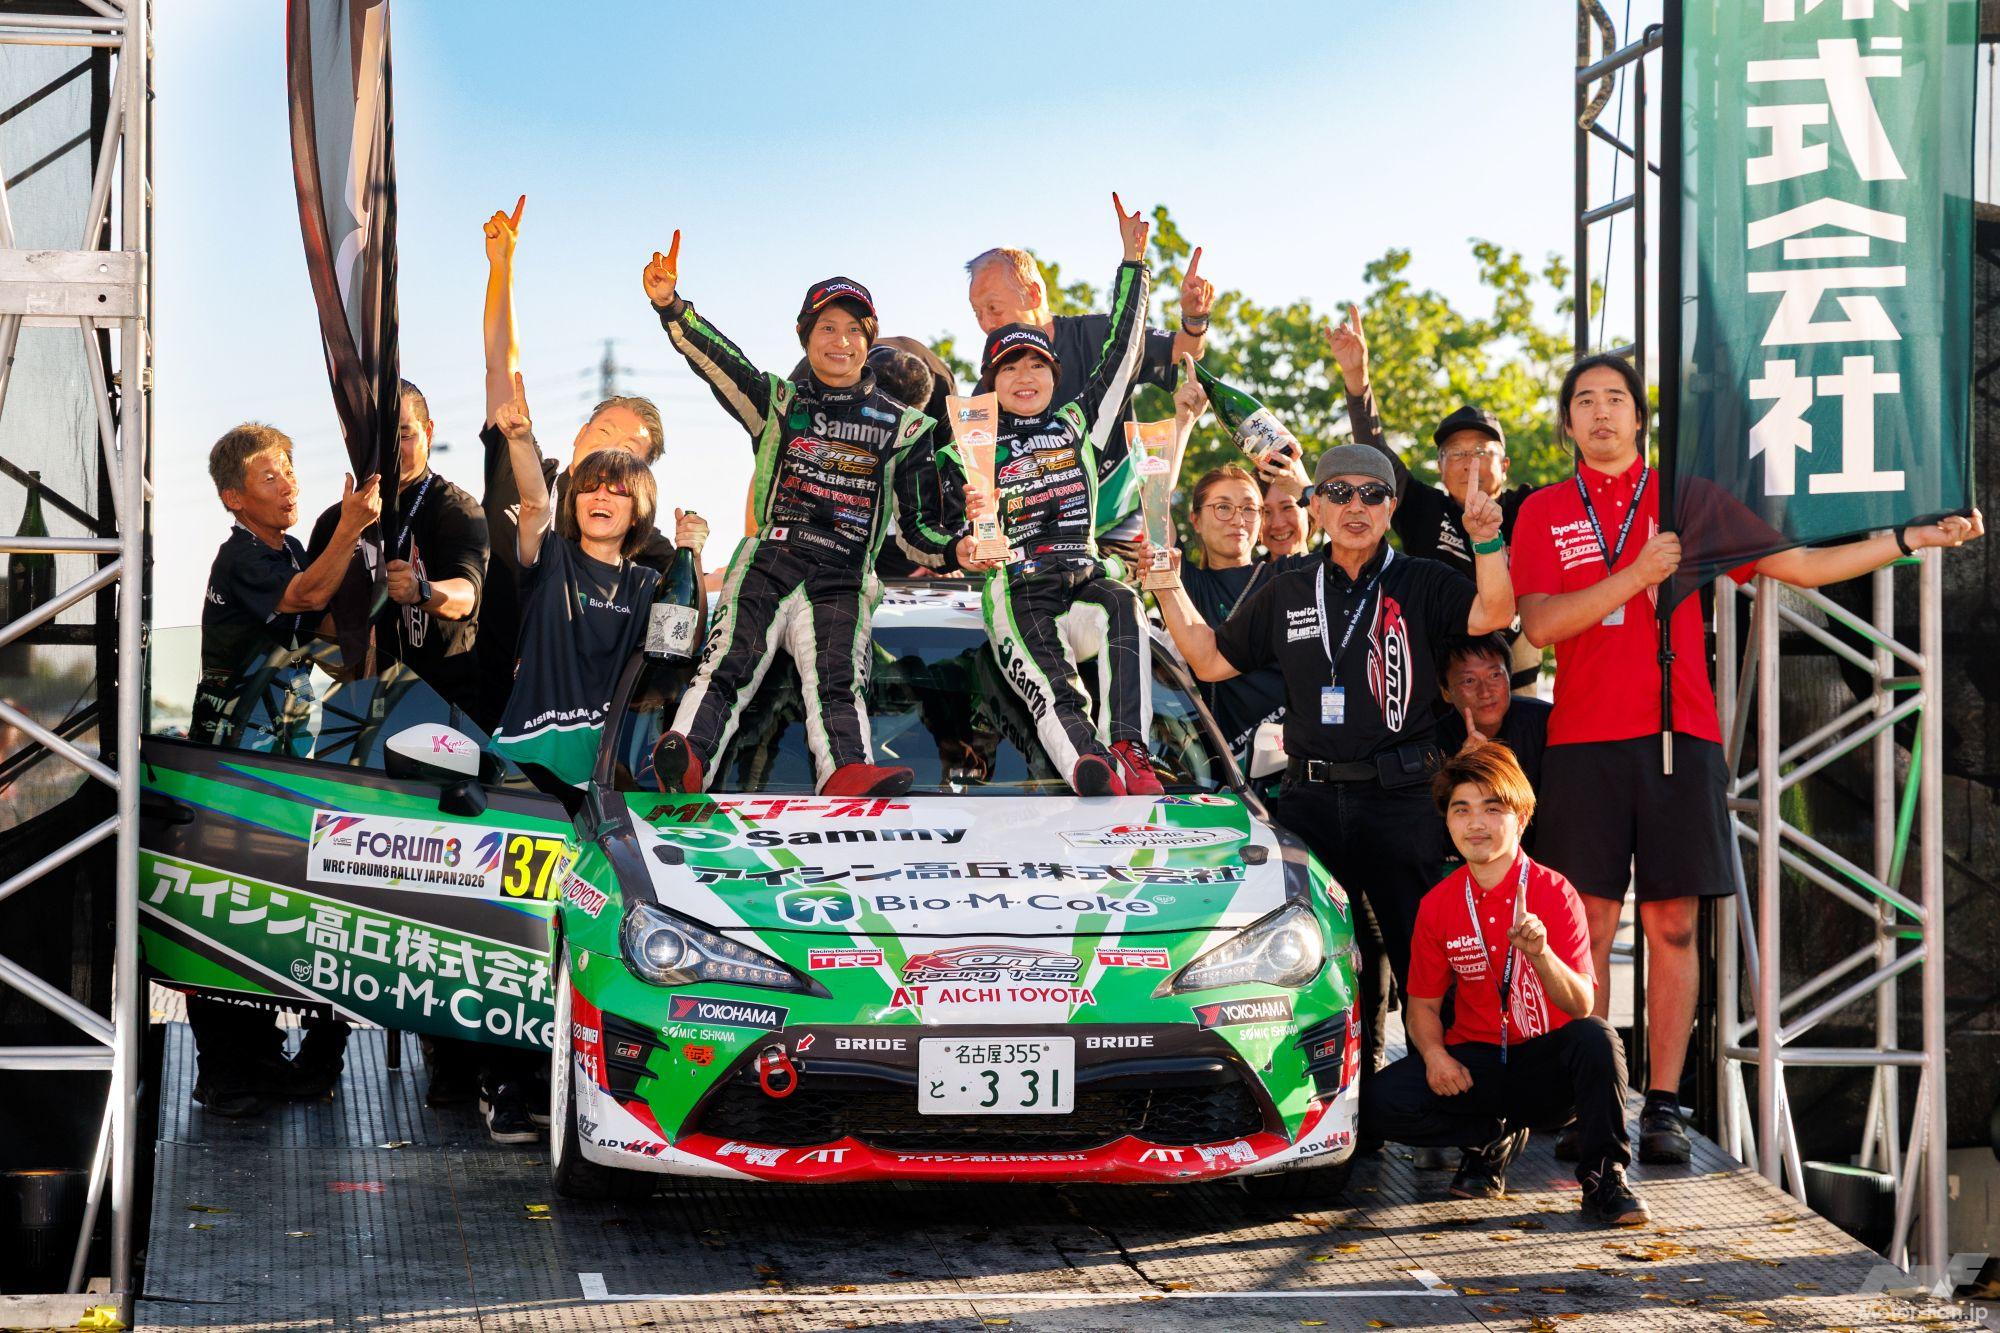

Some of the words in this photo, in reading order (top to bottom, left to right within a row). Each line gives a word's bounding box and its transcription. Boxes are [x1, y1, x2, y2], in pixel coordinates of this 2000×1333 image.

[1747, 0, 1909, 496] 式会社
[1001, 332, 1048, 349] YOKOHAMA
[813, 412, 892, 450] Sammy
[1011, 427, 1075, 458] Sammy
[831, 490, 871, 508] TOYOTA
[1007, 496, 1024, 514] AT
[1287, 608, 1306, 621] kyoei
[524, 710, 556, 729] AISIN
[746, 828, 967, 849] Sammy
[356, 830, 462, 868] FORUM8
[323, 858, 345, 874] WRC
[347, 861, 389, 878] FORUM8
[390, 866, 423, 882] RALLY
[424, 869, 457, 886] JAPAN
[458, 872, 485, 888] 2026
[504, 836, 564, 898] 37
[691, 861, 1246, 887] アイシン高丘株式会社
[569, 879, 607, 916] TOYOTA
[812, 954, 882, 967] TRD
[1101, 954, 1168, 968] TRD
[905, 970, 999, 983] Racing
[1011, 970, 1080, 983] Team
[890, 986, 929, 1008] AT
[938, 988, 1001, 1003] AICHI
[1006, 988, 1097, 1005] TOYOTA
[698, 1003, 776, 1025] YOKOHAMA
[1222, 1002, 1287, 1021] YOKOHAMA
[662, 1024, 697, 1039] SOMIC
[836, 1039, 906, 1051] BRIDE
[1086, 1035, 1154, 1048] BRIDE
[1315, 1044, 1335, 1057] GR
[617, 1047, 639, 1057] GR
[598, 1139, 658, 1156] ADVAN
[1300, 1134, 1349, 1154] ADVAN
